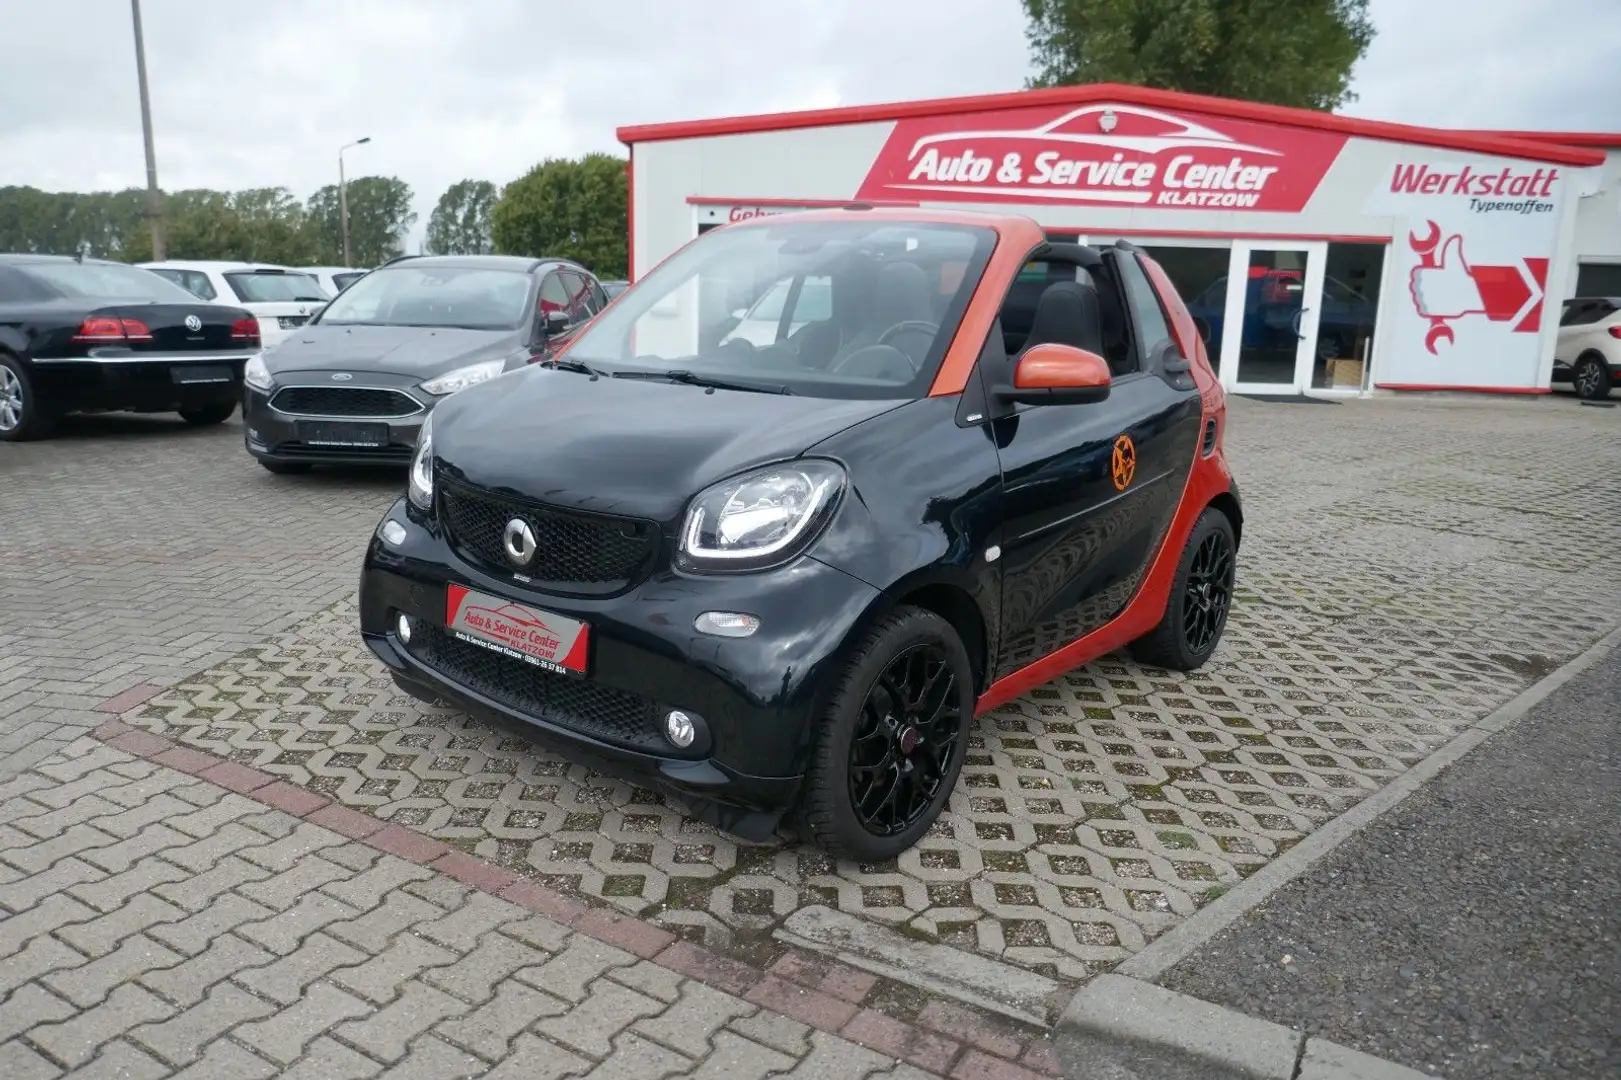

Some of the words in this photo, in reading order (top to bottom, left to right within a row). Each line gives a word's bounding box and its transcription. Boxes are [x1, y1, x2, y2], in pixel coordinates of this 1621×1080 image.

[909, 147, 993, 183] Auto
[996, 152, 1023, 183] &
[1028, 151, 1154, 188] Service
[1163, 155, 1279, 191] Center
[1389, 163, 1559, 197] Werkstatt
[1157, 191, 1260, 208] KLATZOW
[1468, 198, 1554, 214] Typenoffen
[464, 611, 484, 627] Auto
[485, 618, 492, 629] &
[493, 619, 527, 640] Service
[529, 630, 560, 650] Center
[455, 631, 466, 641] Auto
[470, 636, 488, 648] Service
[487, 642, 504, 653] Center
[510, 639, 556, 660] KLATZOW
